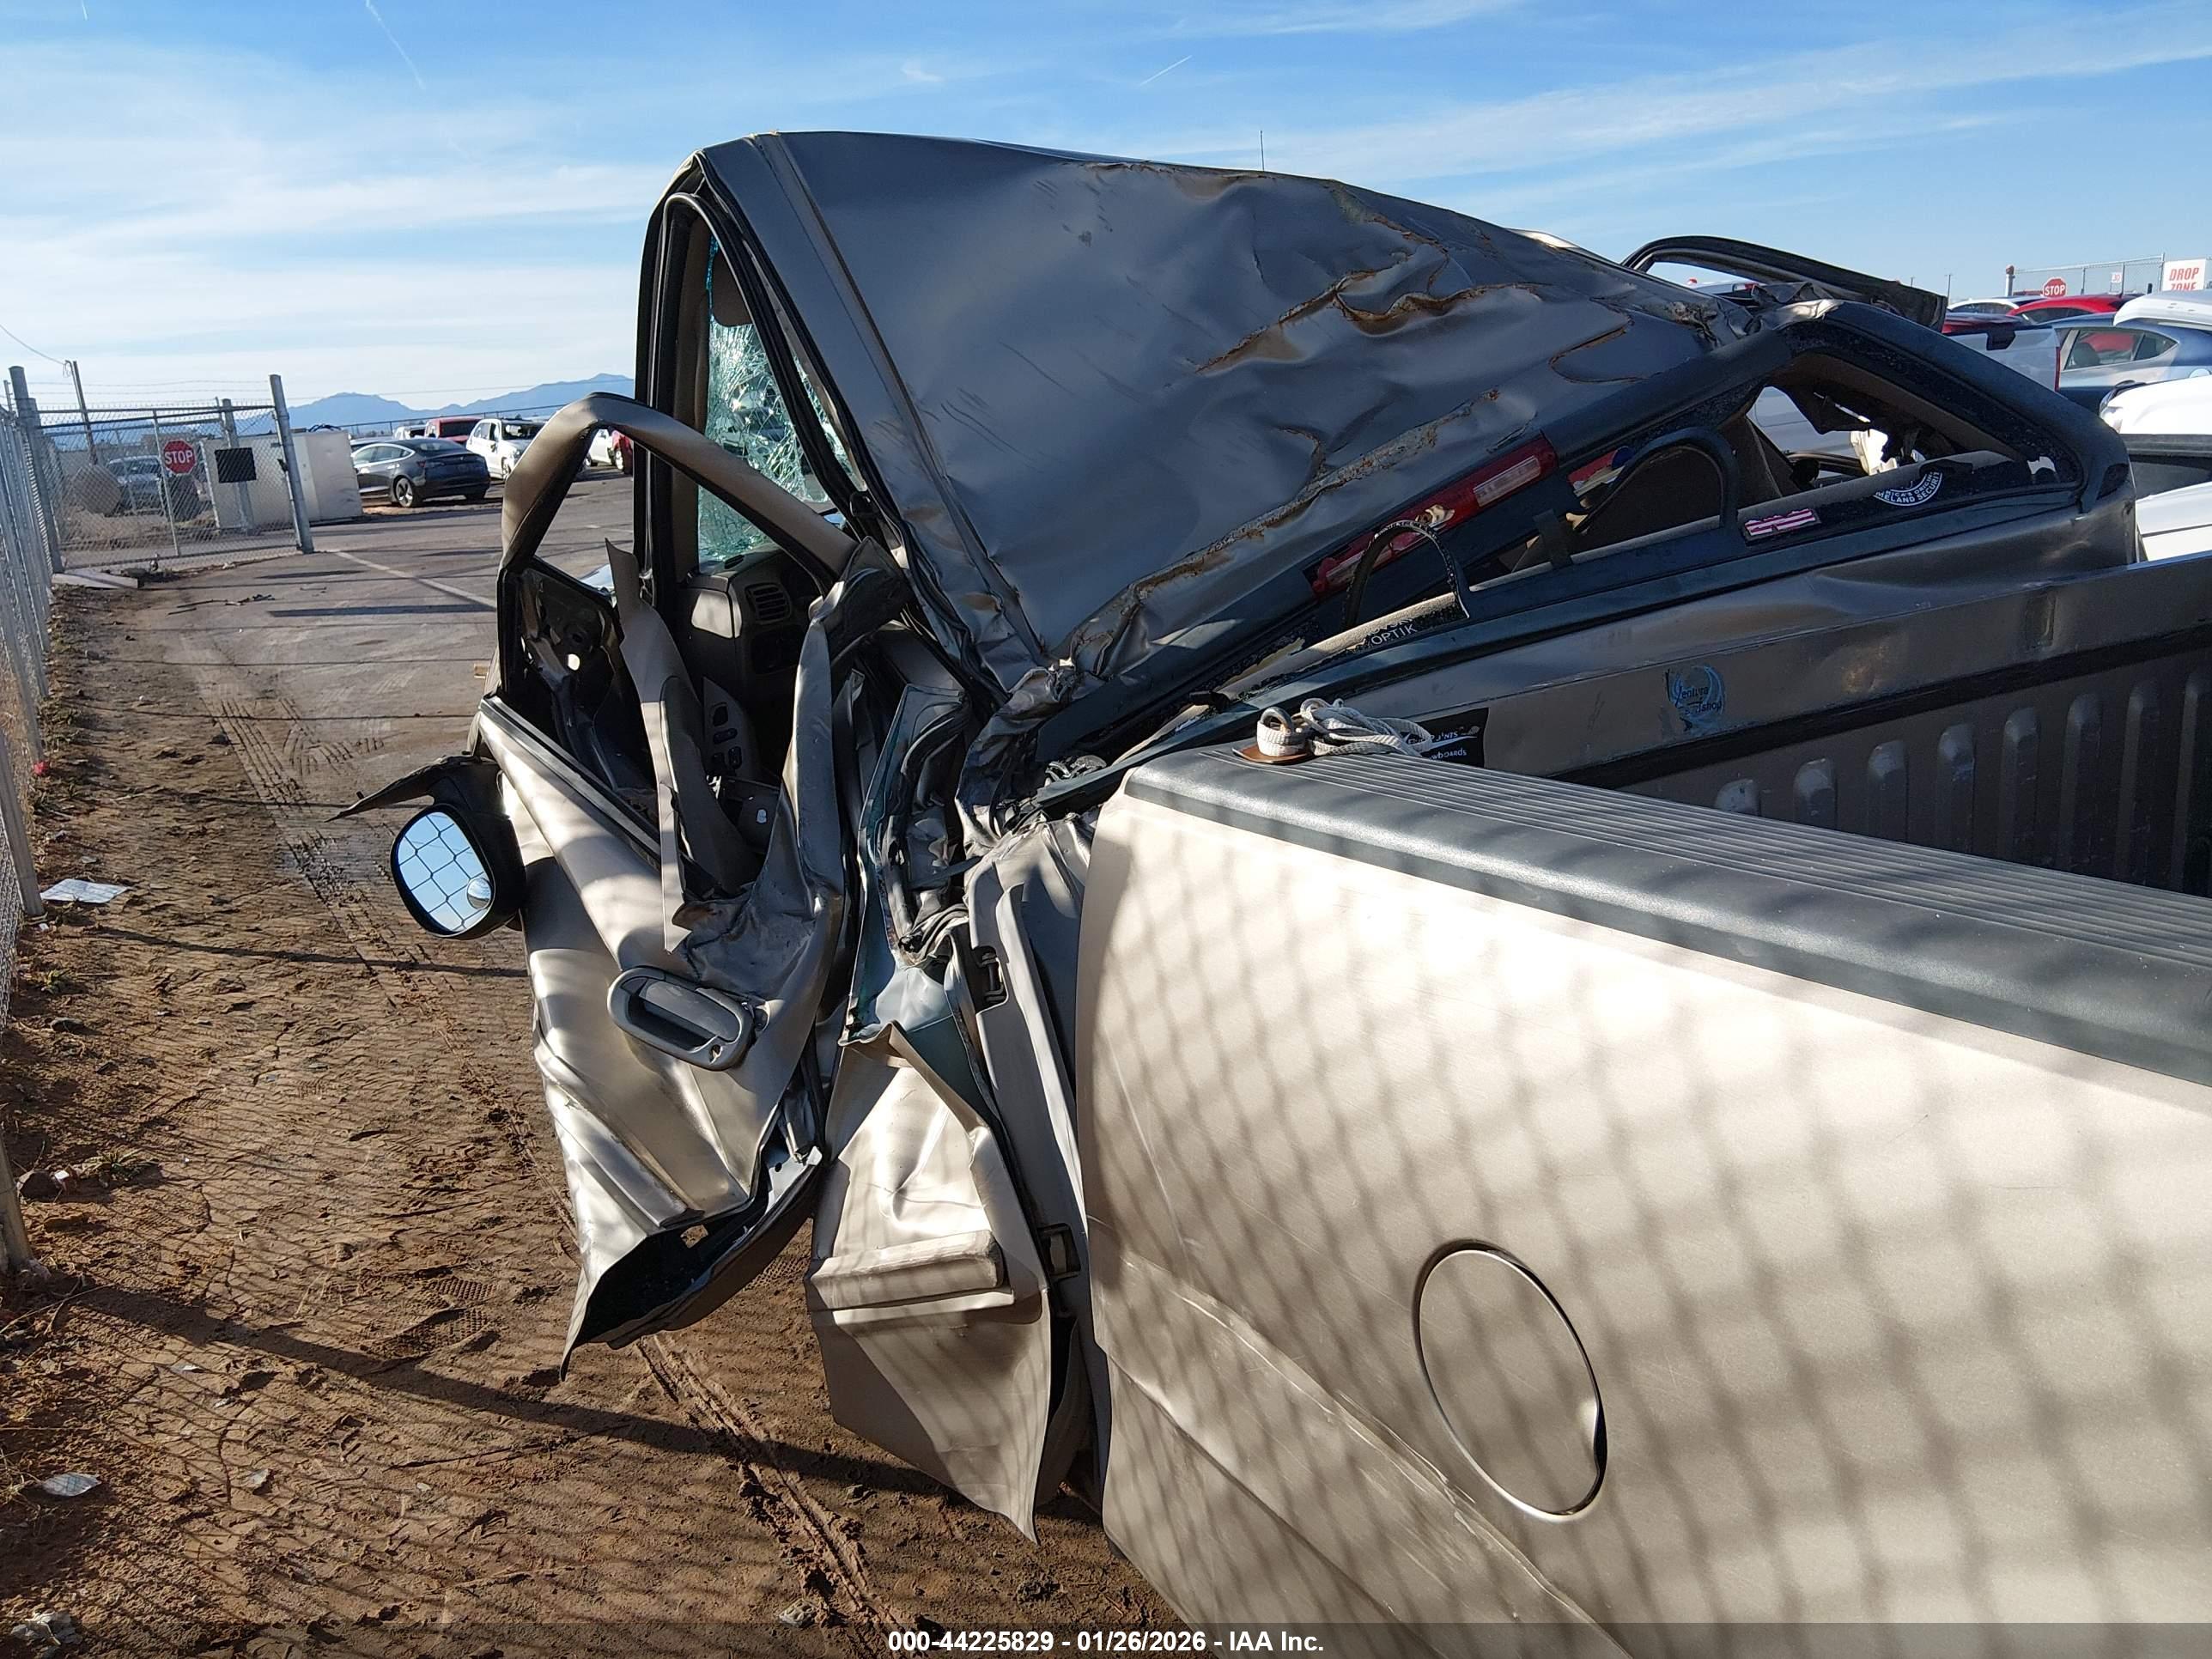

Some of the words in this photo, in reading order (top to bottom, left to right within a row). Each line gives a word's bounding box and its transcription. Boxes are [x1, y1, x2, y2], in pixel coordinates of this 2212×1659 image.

[2168, 267, 2200, 282] DROP
[2045, 285, 2066, 296] STOP
[2170, 282, 2197, 292] ZONE
[164, 450, 193, 465] STOP
[1370, 623, 1419, 645] OPTIK
